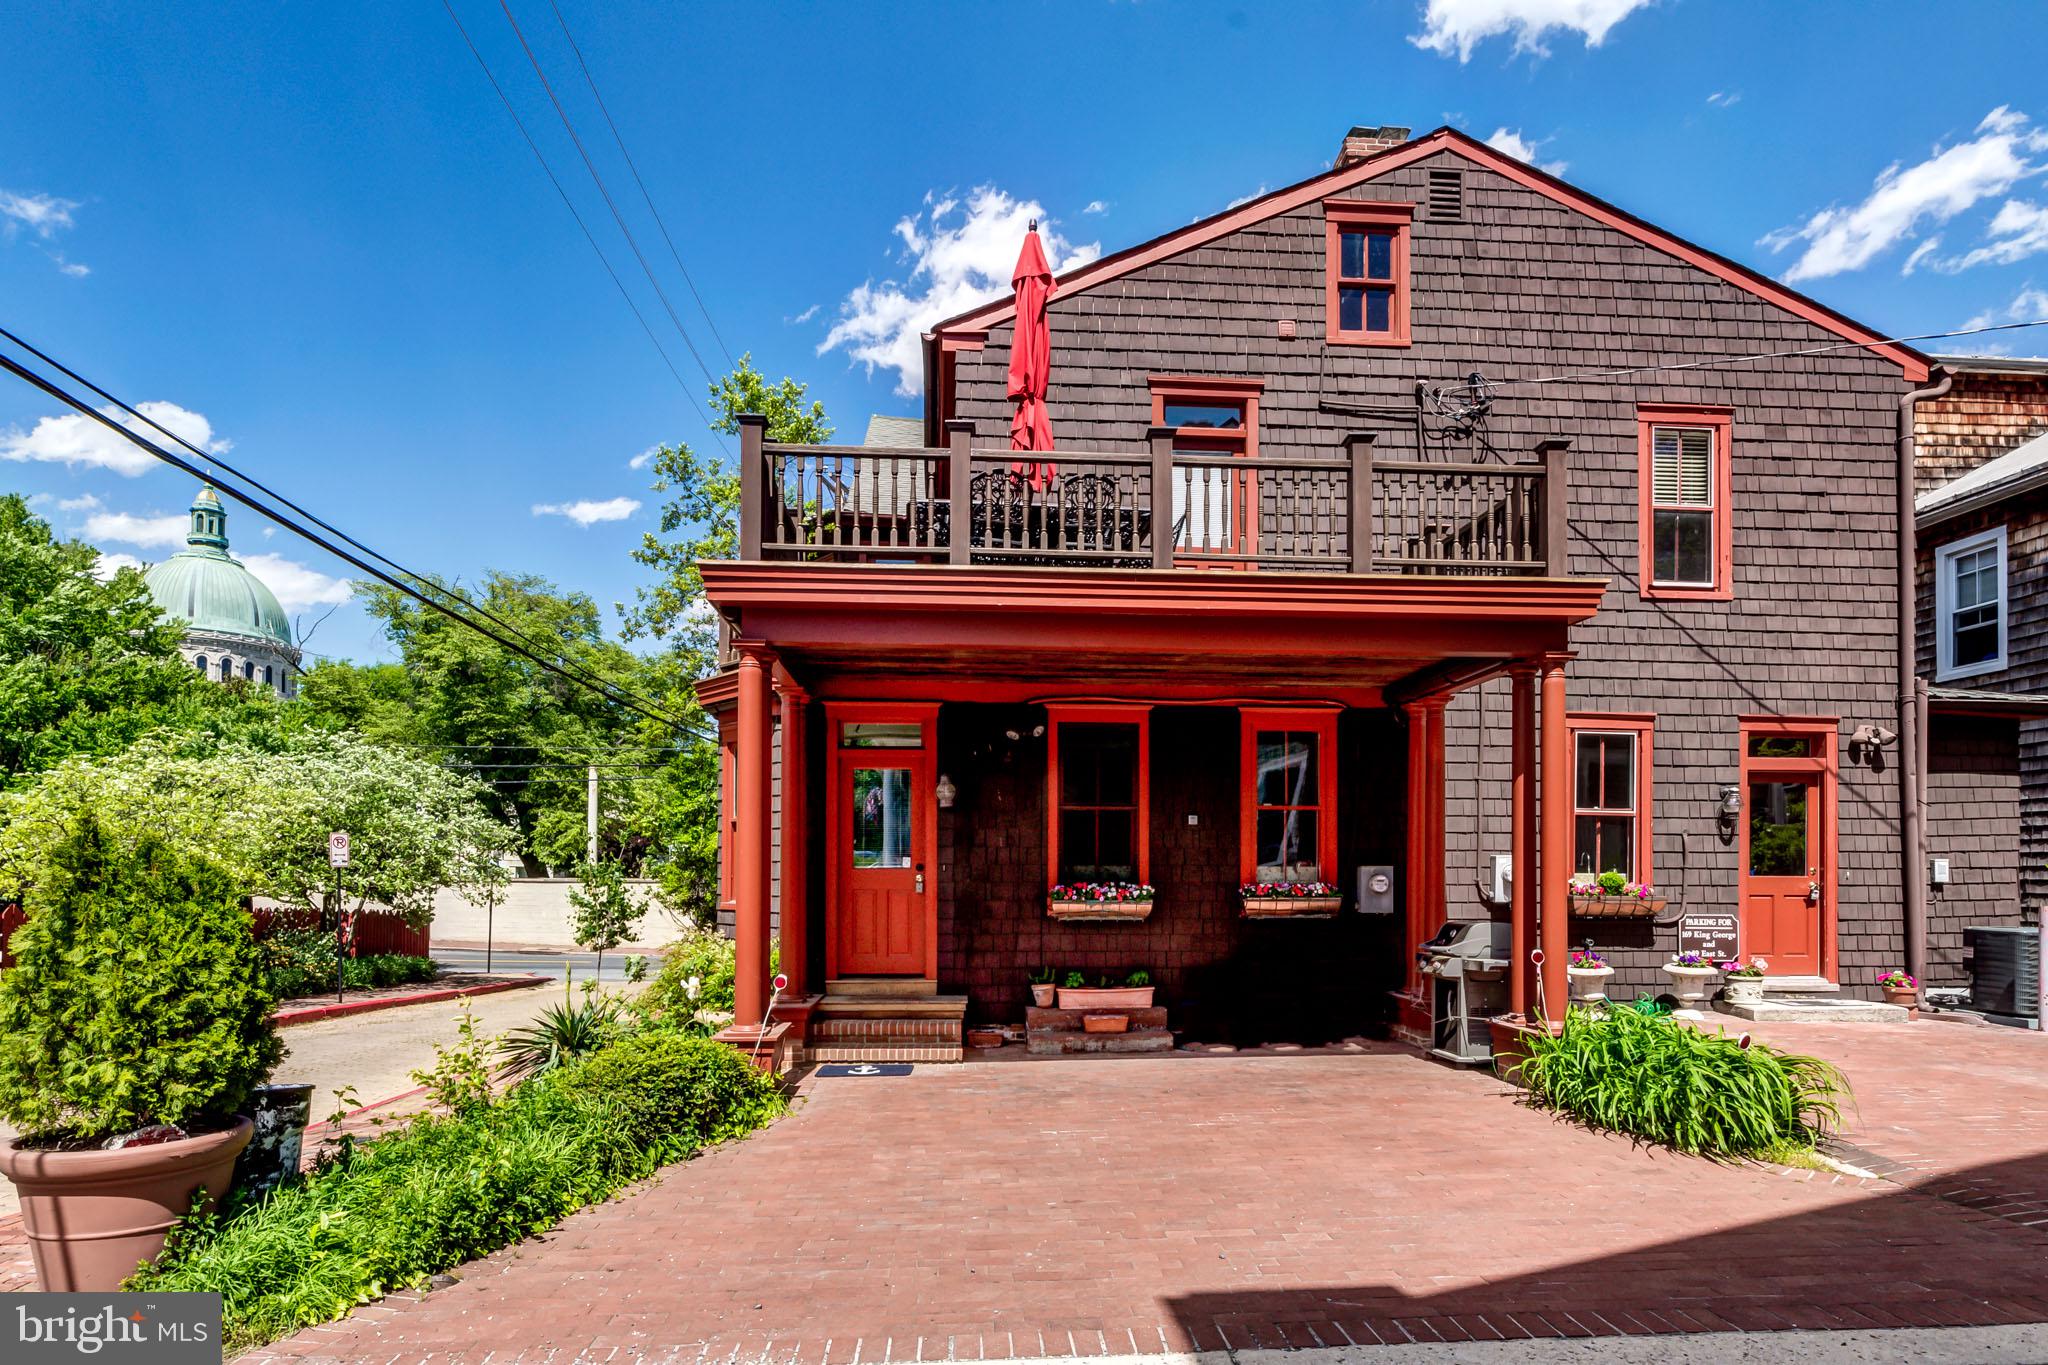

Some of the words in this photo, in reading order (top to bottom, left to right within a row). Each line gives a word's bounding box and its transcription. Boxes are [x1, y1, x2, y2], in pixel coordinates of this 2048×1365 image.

[1685, 918, 1717, 926] PARKING
[1718, 918, 1732, 926] FOR
[1694, 931, 1710, 940] King
[1712, 931, 1736, 940] George
